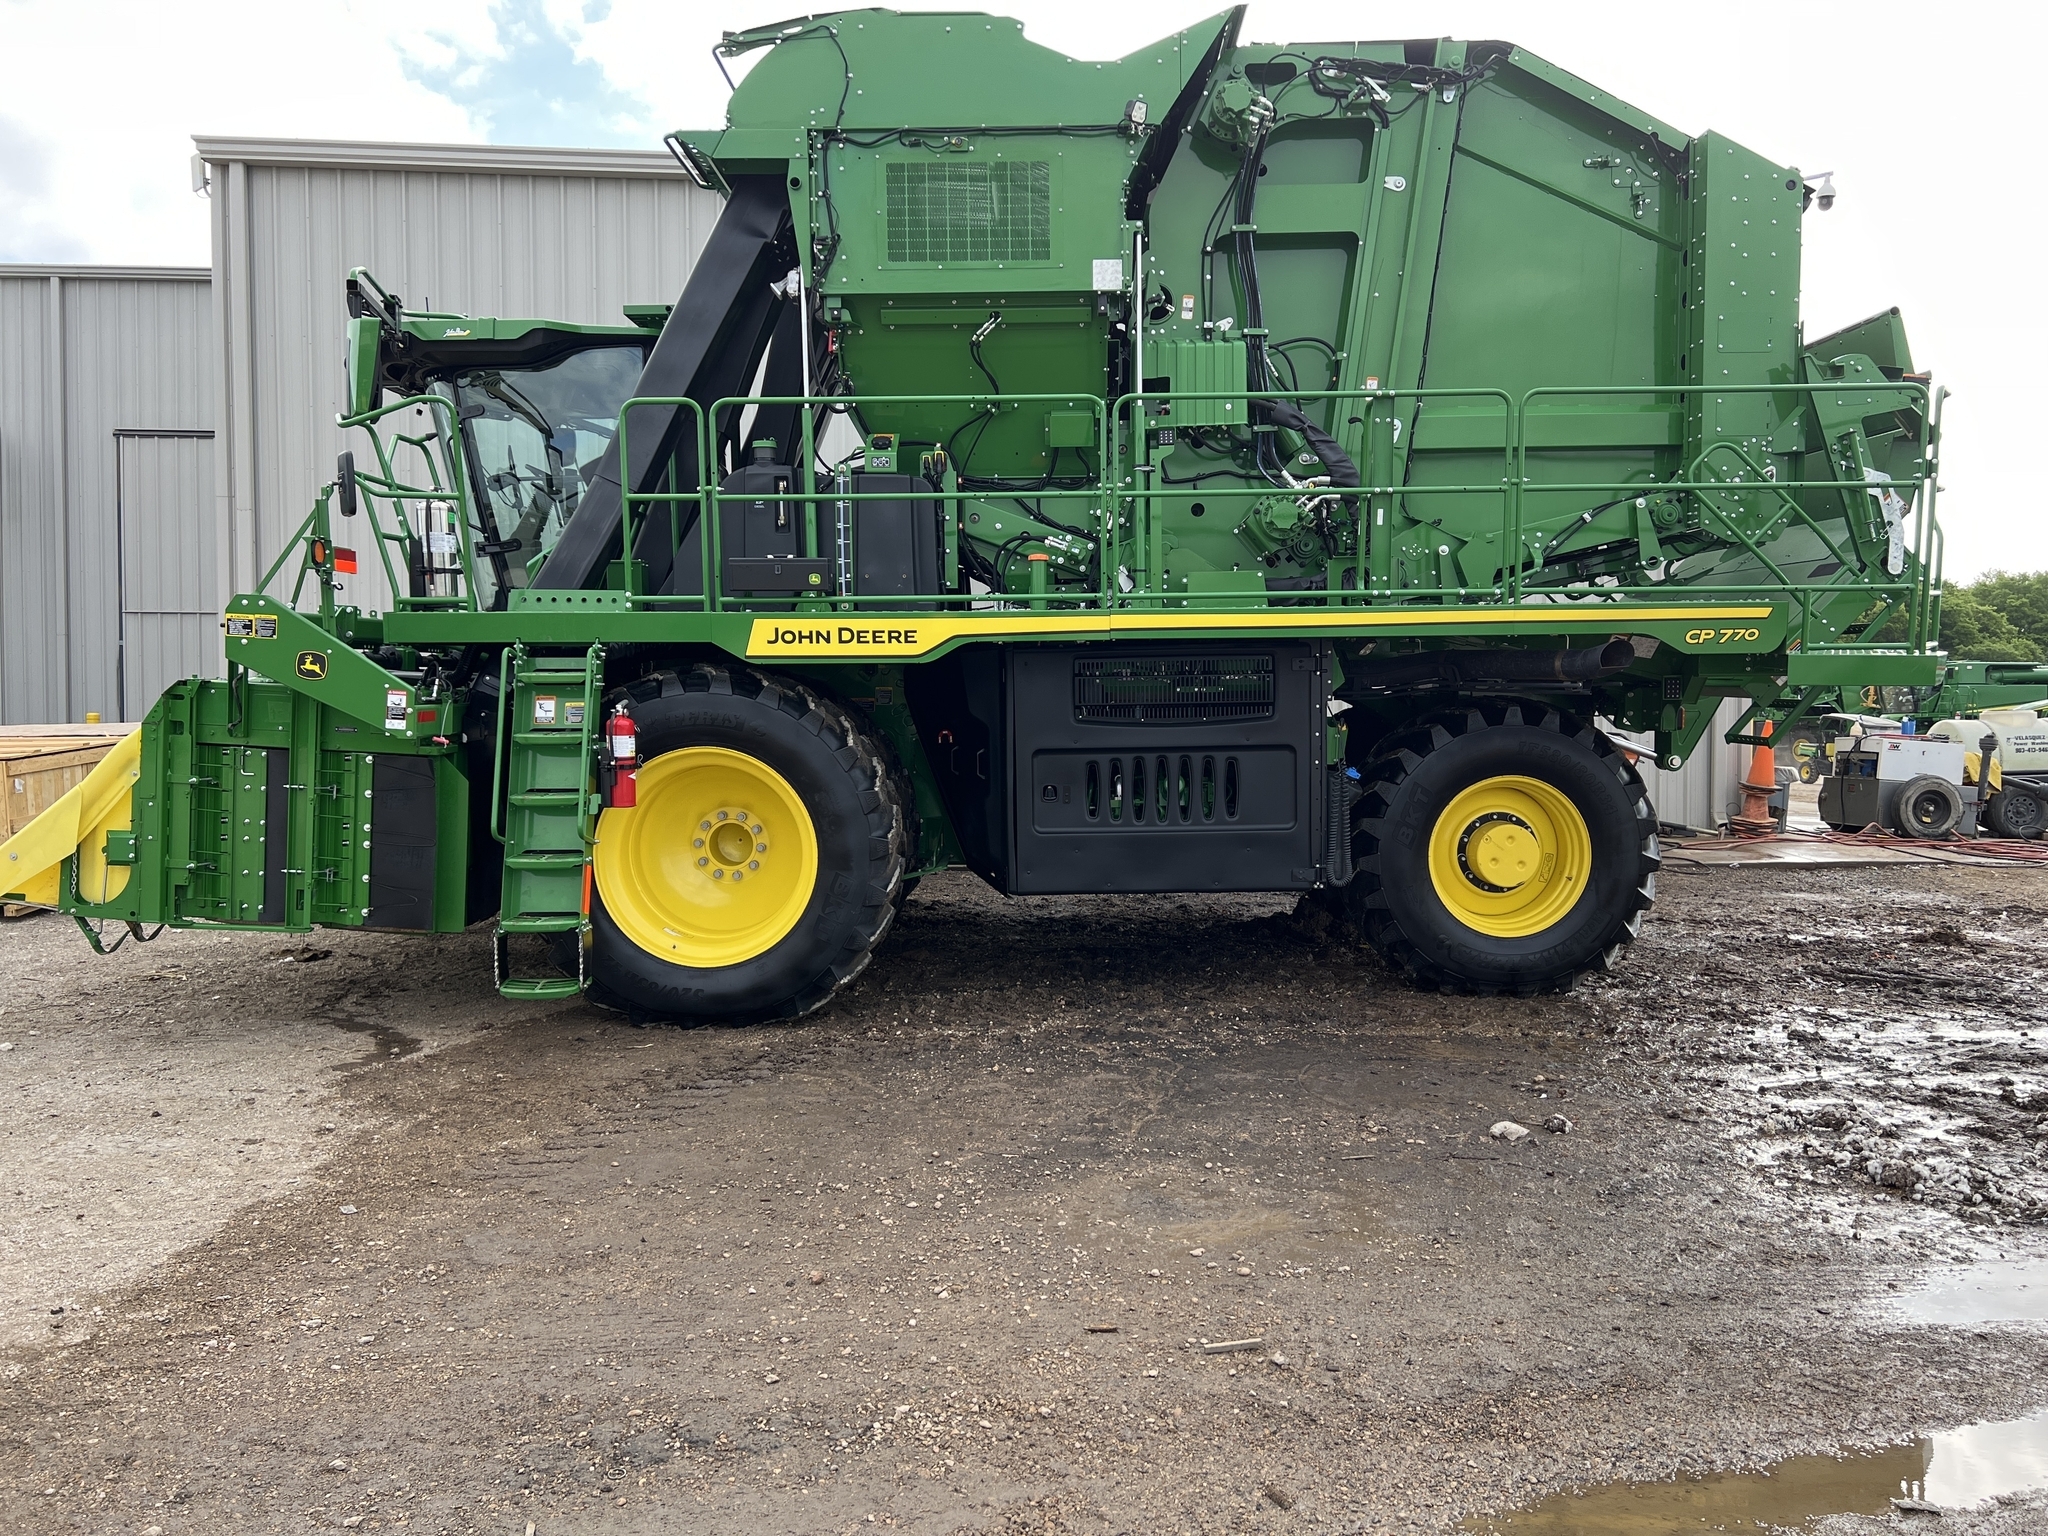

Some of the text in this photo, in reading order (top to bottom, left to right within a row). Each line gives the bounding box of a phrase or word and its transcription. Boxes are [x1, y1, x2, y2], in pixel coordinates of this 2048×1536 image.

[766, 627, 918, 645] JOHN DEERE
[1684, 628, 1761, 645] CP 770
[1396, 786, 1430, 846] BKT
[817, 874, 855, 942] BKT
